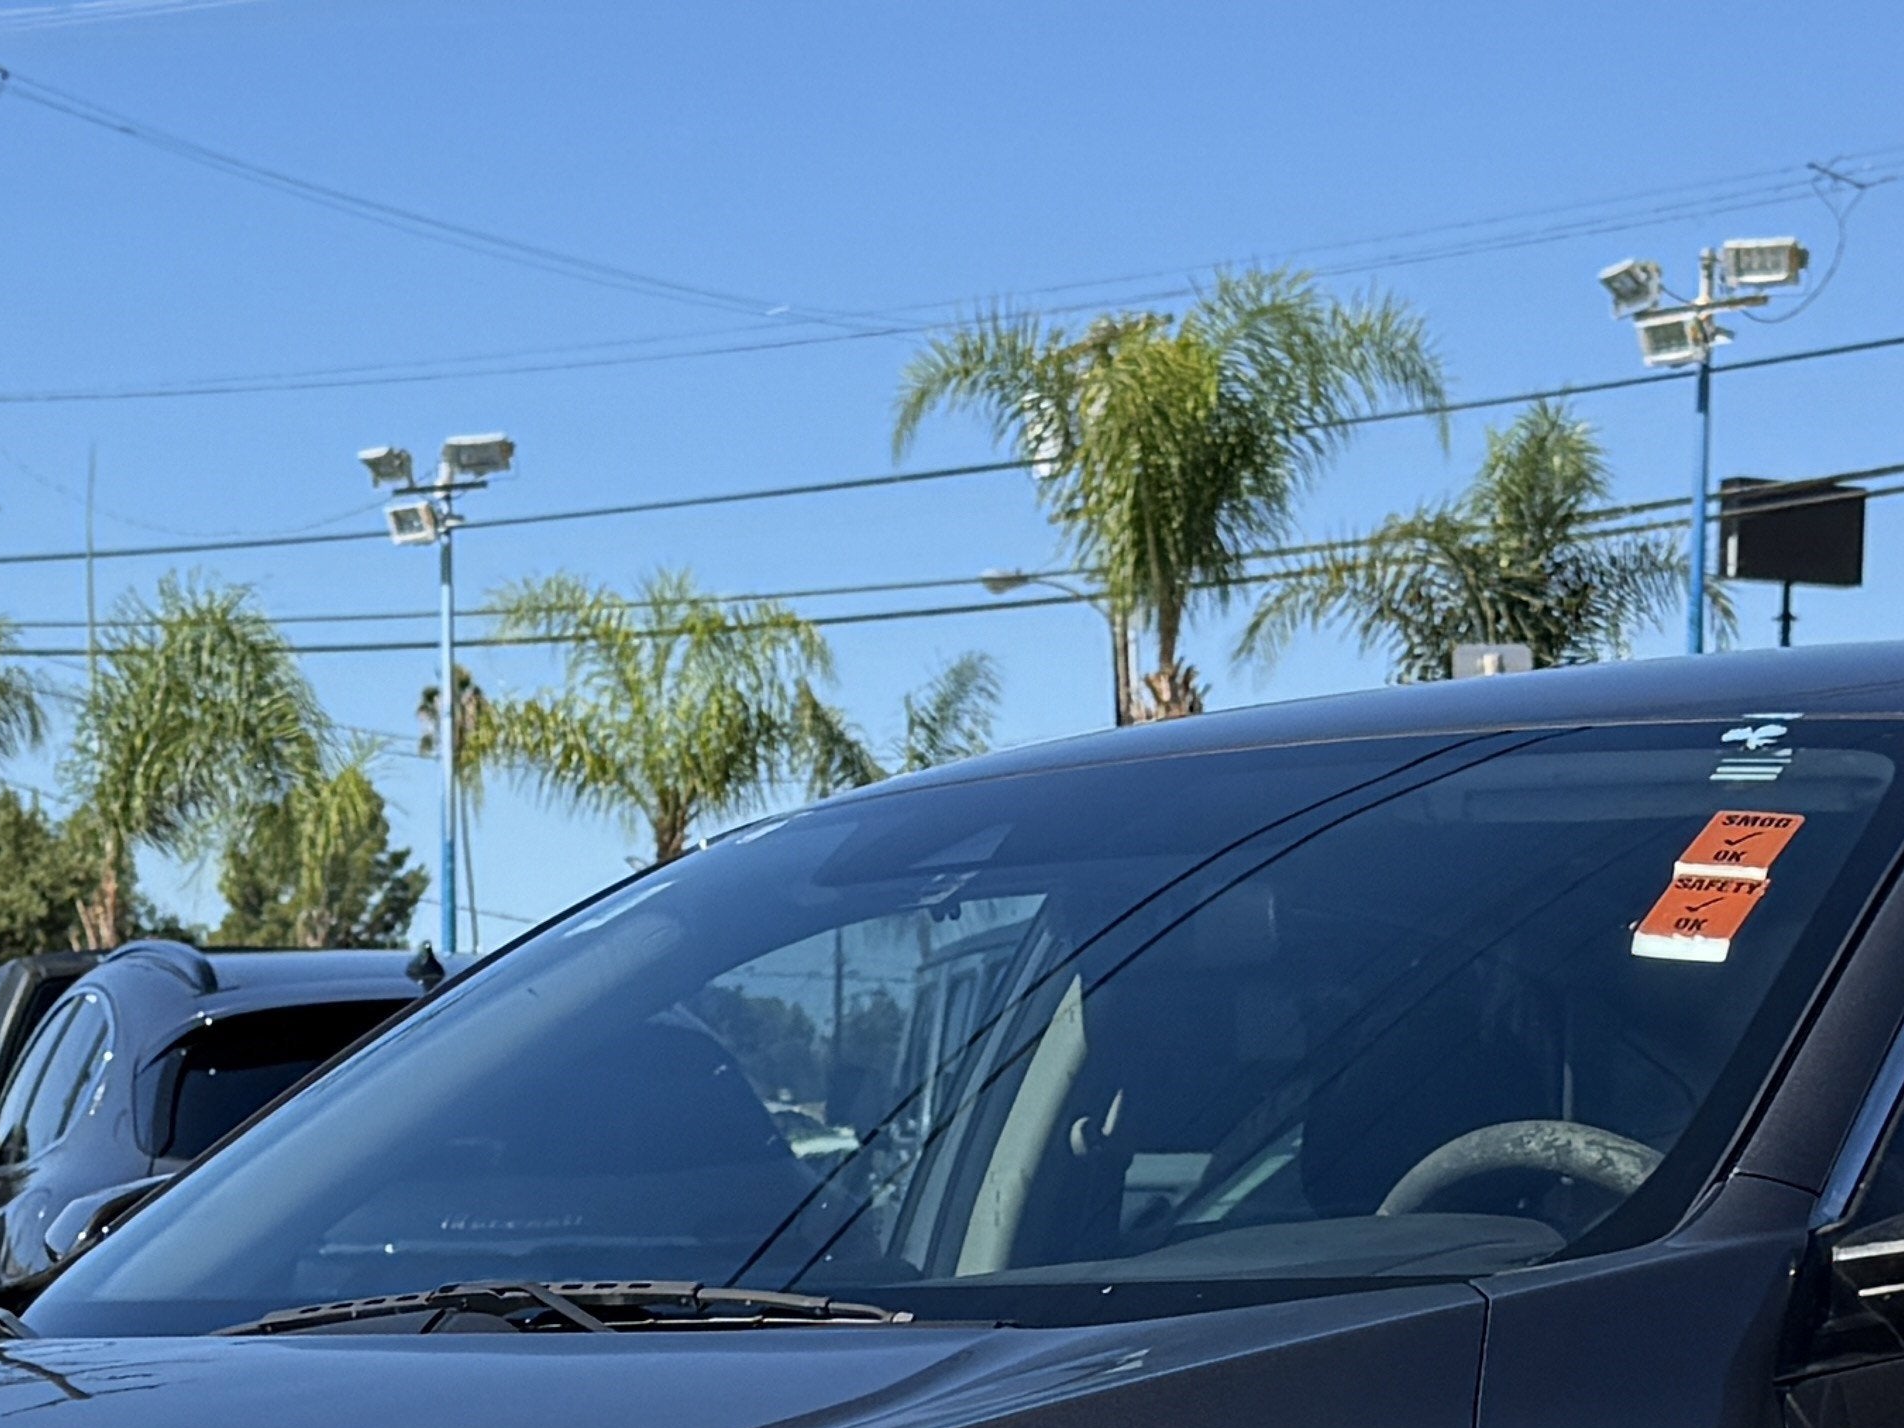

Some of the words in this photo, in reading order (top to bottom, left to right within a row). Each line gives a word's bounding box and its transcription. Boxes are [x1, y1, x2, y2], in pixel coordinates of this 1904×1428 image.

[1722, 815, 1793, 828] SMOG
[1713, 850, 1747, 862] OK
[1675, 877, 1762, 894] SAFETY
[1674, 918, 1708, 931] OK
